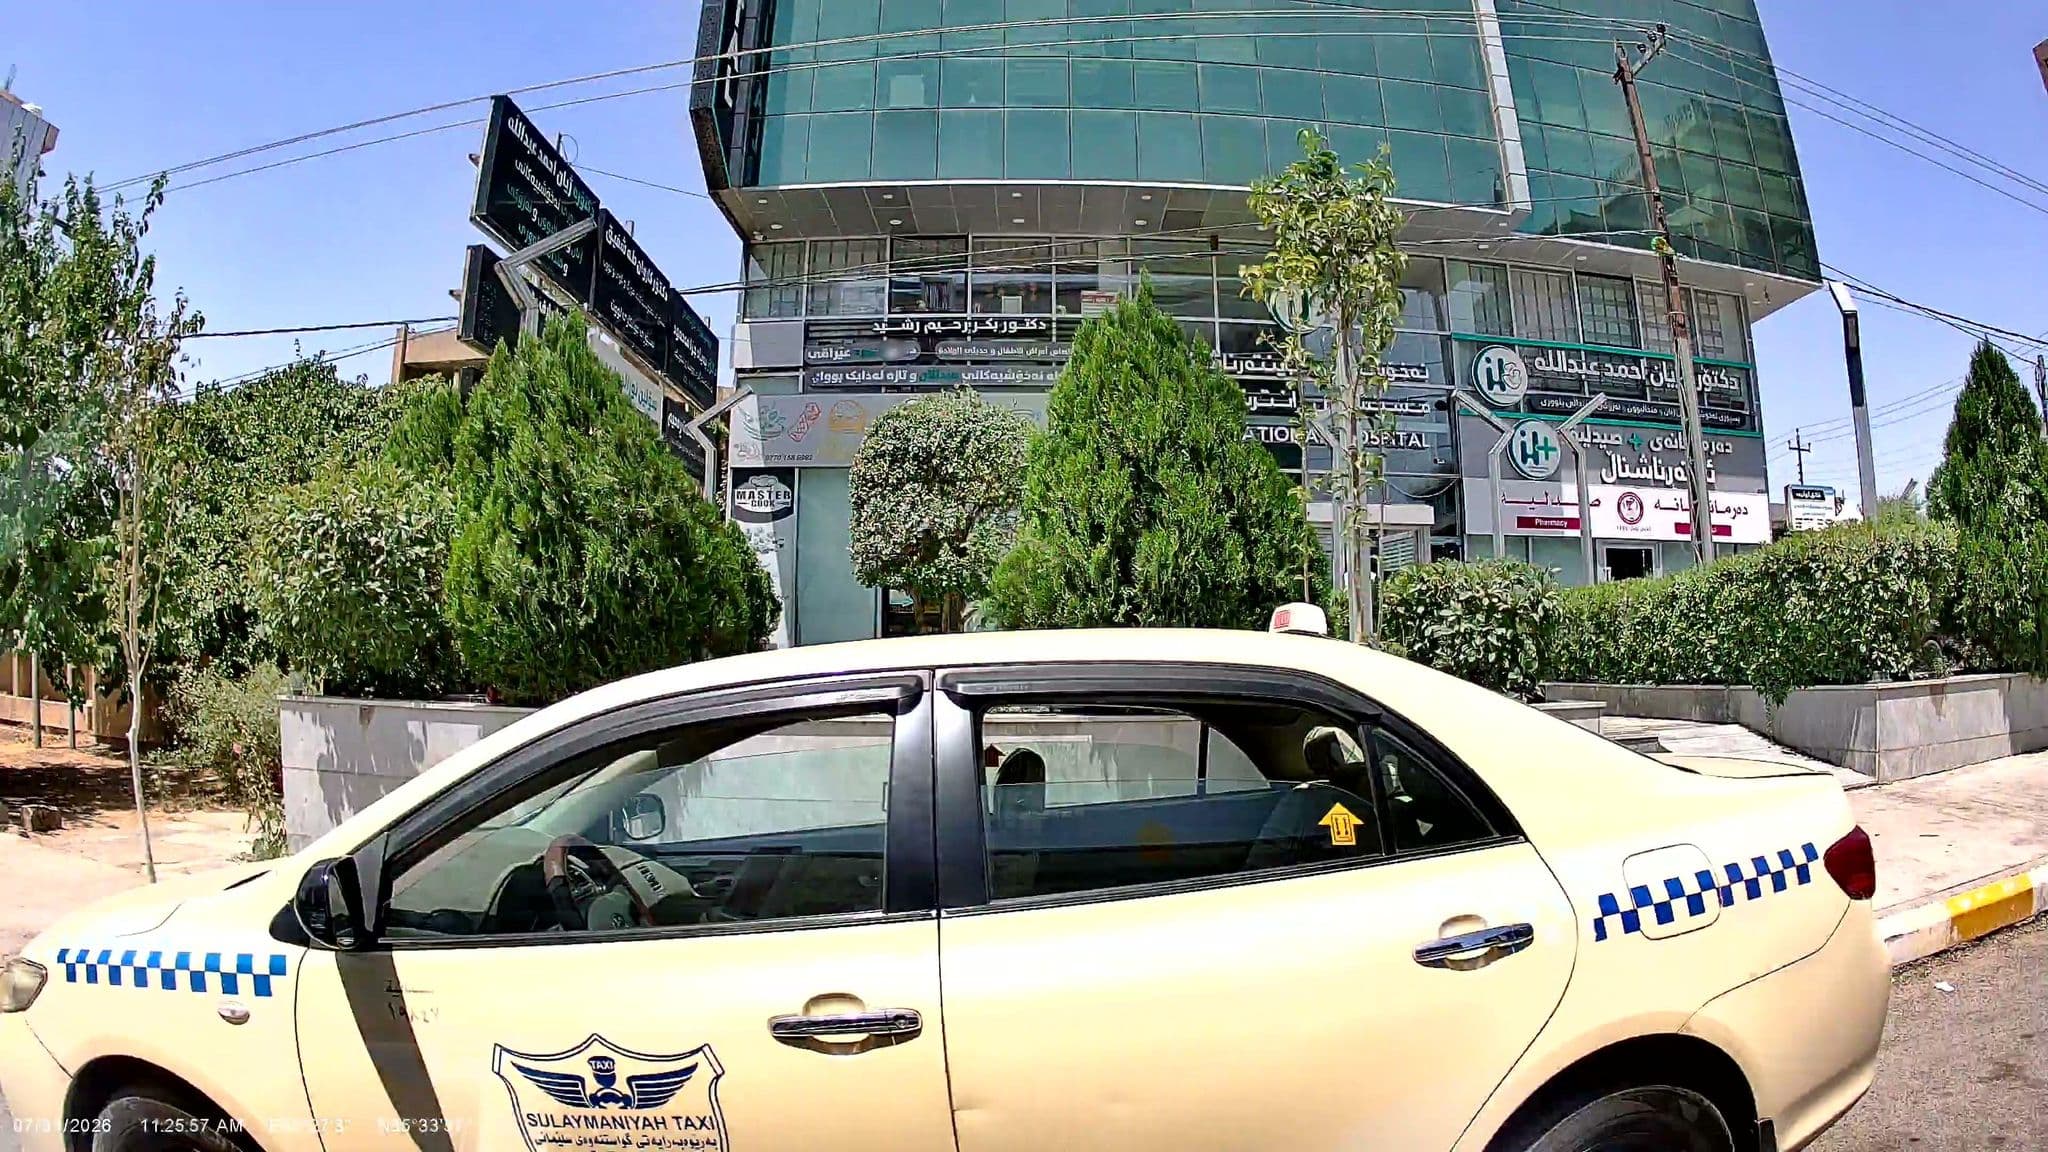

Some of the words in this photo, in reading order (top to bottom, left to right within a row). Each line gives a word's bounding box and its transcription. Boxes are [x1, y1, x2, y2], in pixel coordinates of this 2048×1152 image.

[736, 490, 792, 500] MASTER
[590, 1059, 613, 1071] TAXI
[526, 1113, 667, 1130] SULAYMANIYAH
[671, 1116, 716, 1131] TAXI
